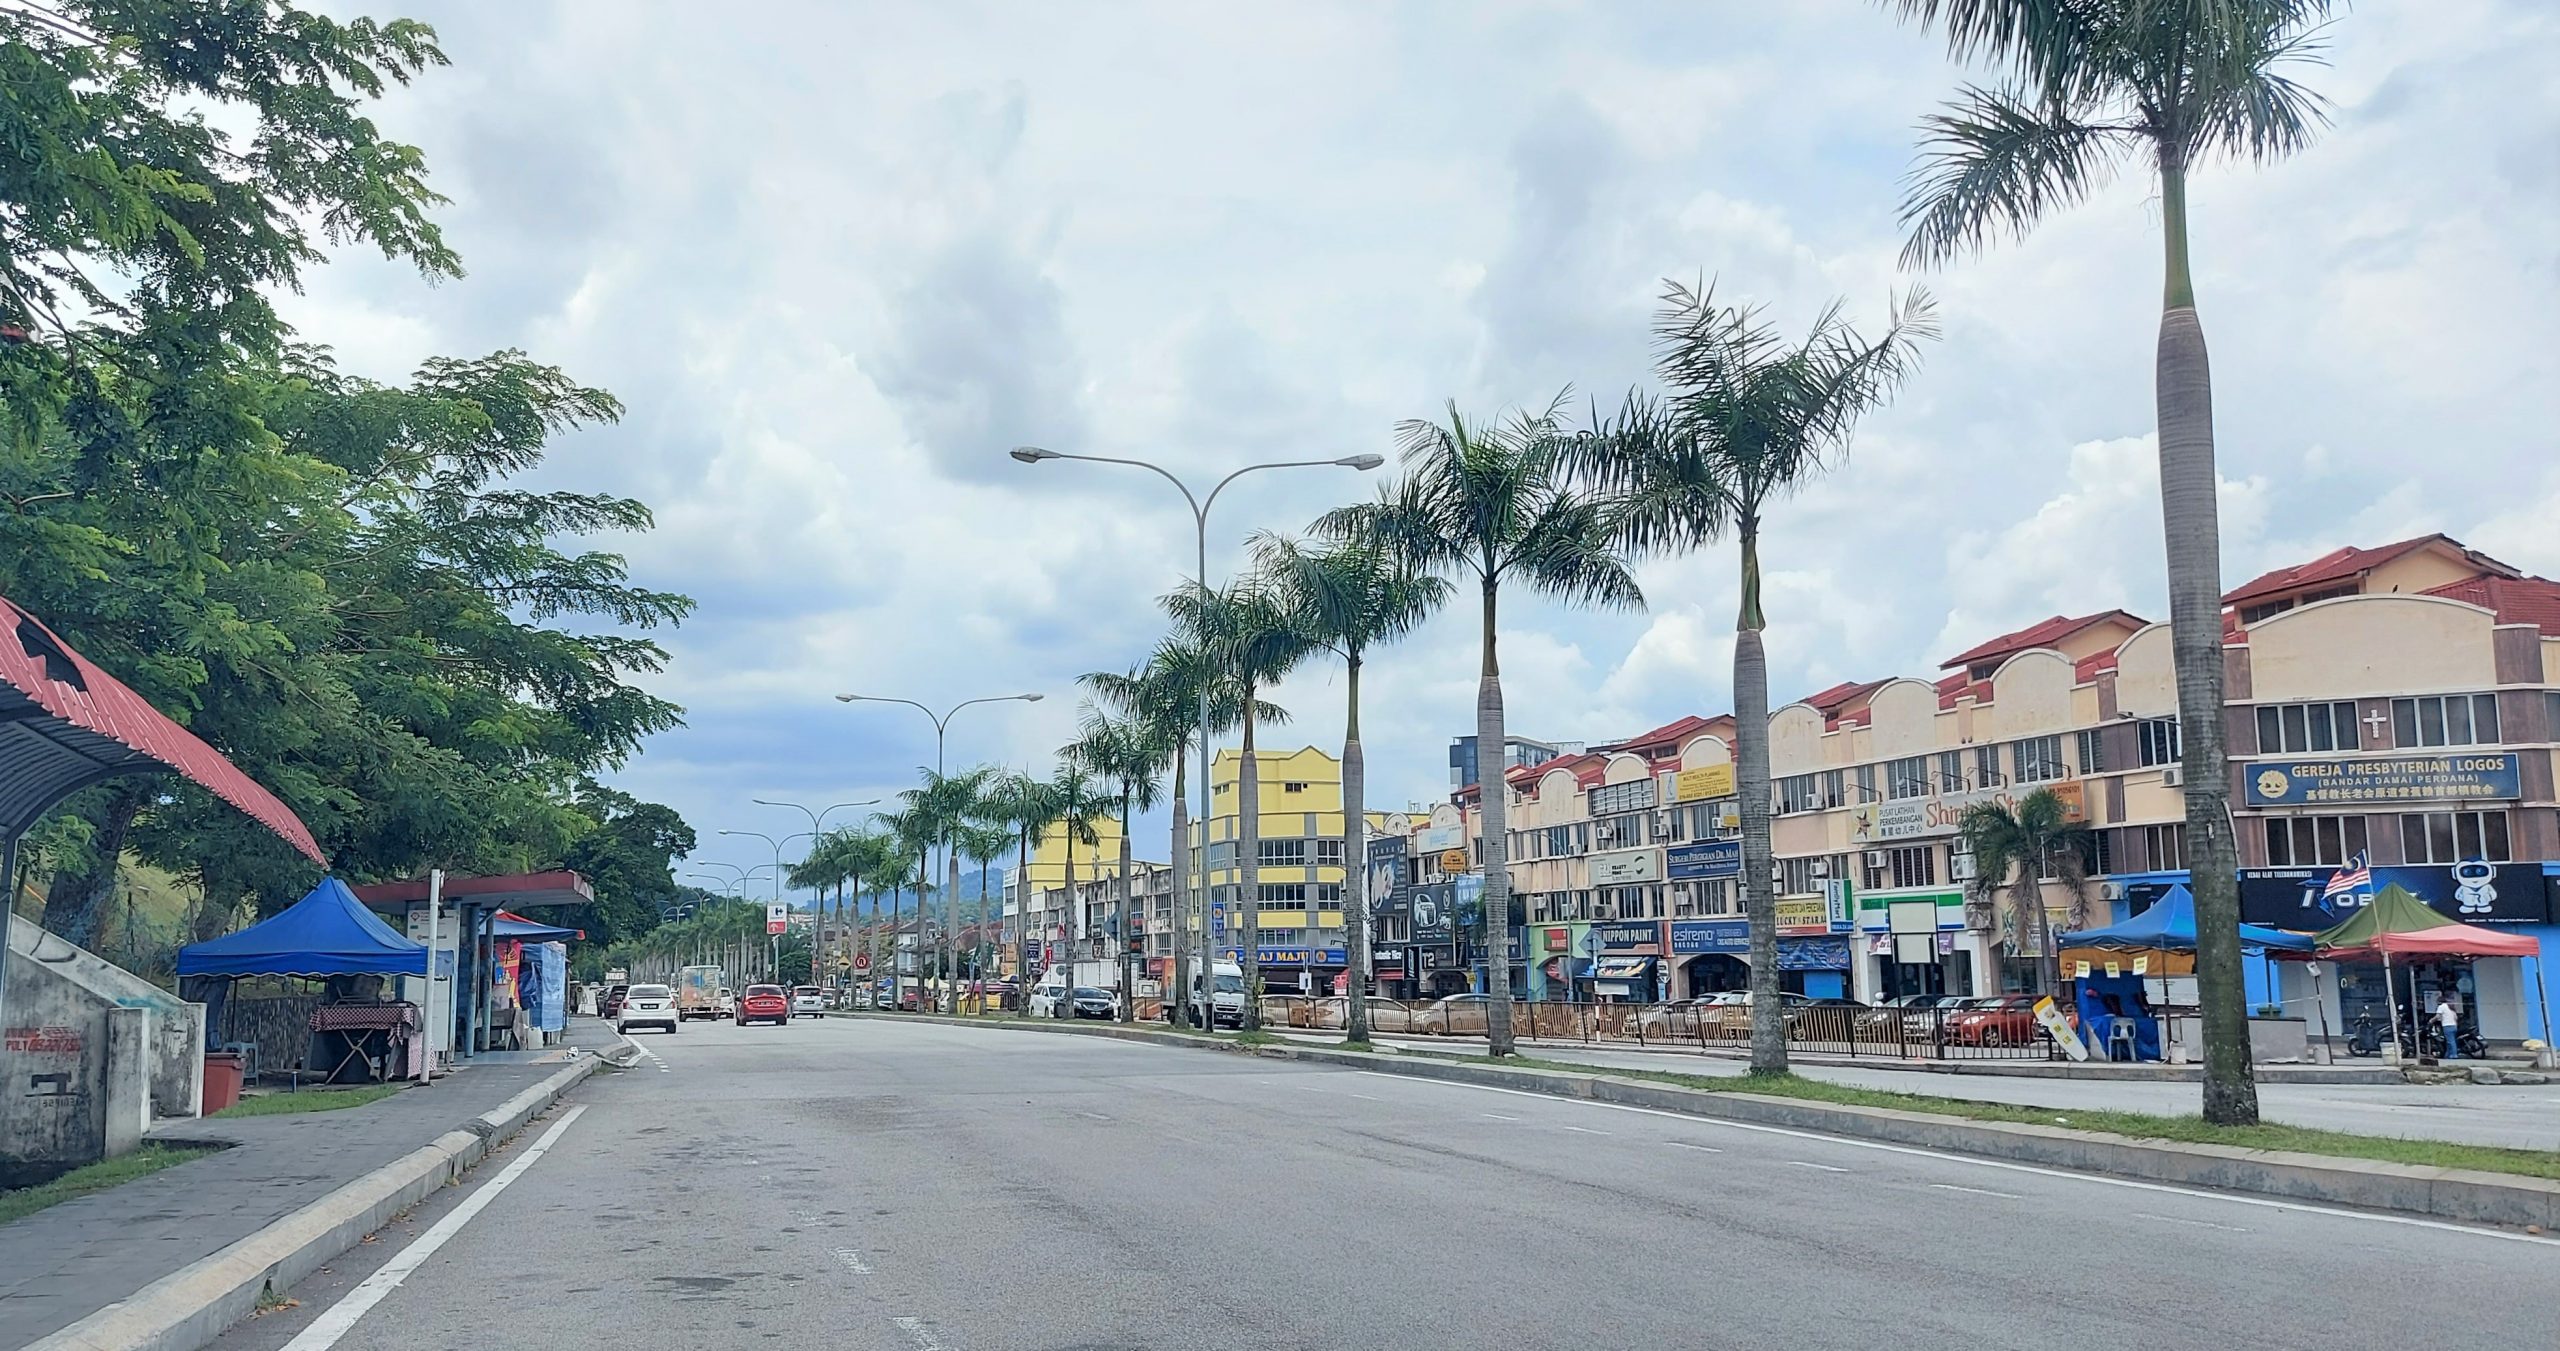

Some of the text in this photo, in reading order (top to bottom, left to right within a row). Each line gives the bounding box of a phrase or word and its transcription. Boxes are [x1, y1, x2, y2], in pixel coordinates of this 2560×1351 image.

[2292, 758, 2505, 777] GEREJA PRESBYTERIAN LOGOS
[2318, 774, 2478, 788] (BANDAR DAMAI PERDANA)
[1880, 814, 1922, 827] PERKEMBANGAN
[1776, 916, 1796, 926] LUCKY
[1802, 916, 1818, 925] STAR
[1602, 928, 1652, 943] NIPPON PAINT
[1673, 928, 1713, 941] estremo
[1259, 951, 1309, 962] AJ MAJU
